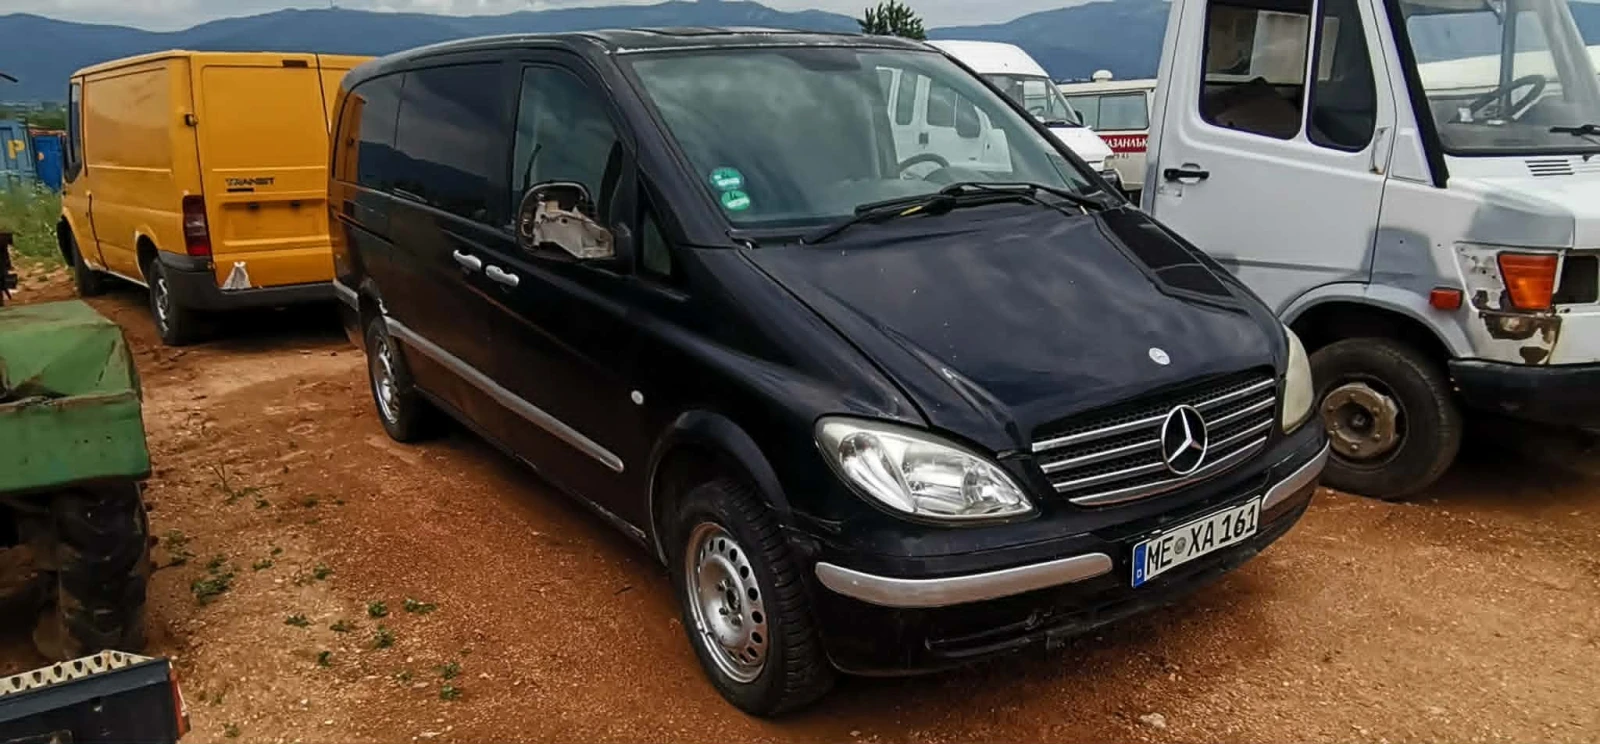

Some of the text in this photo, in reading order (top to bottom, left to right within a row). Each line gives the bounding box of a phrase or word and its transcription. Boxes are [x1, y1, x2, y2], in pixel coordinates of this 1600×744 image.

[1147, 504, 1256, 575] ME XA 161
